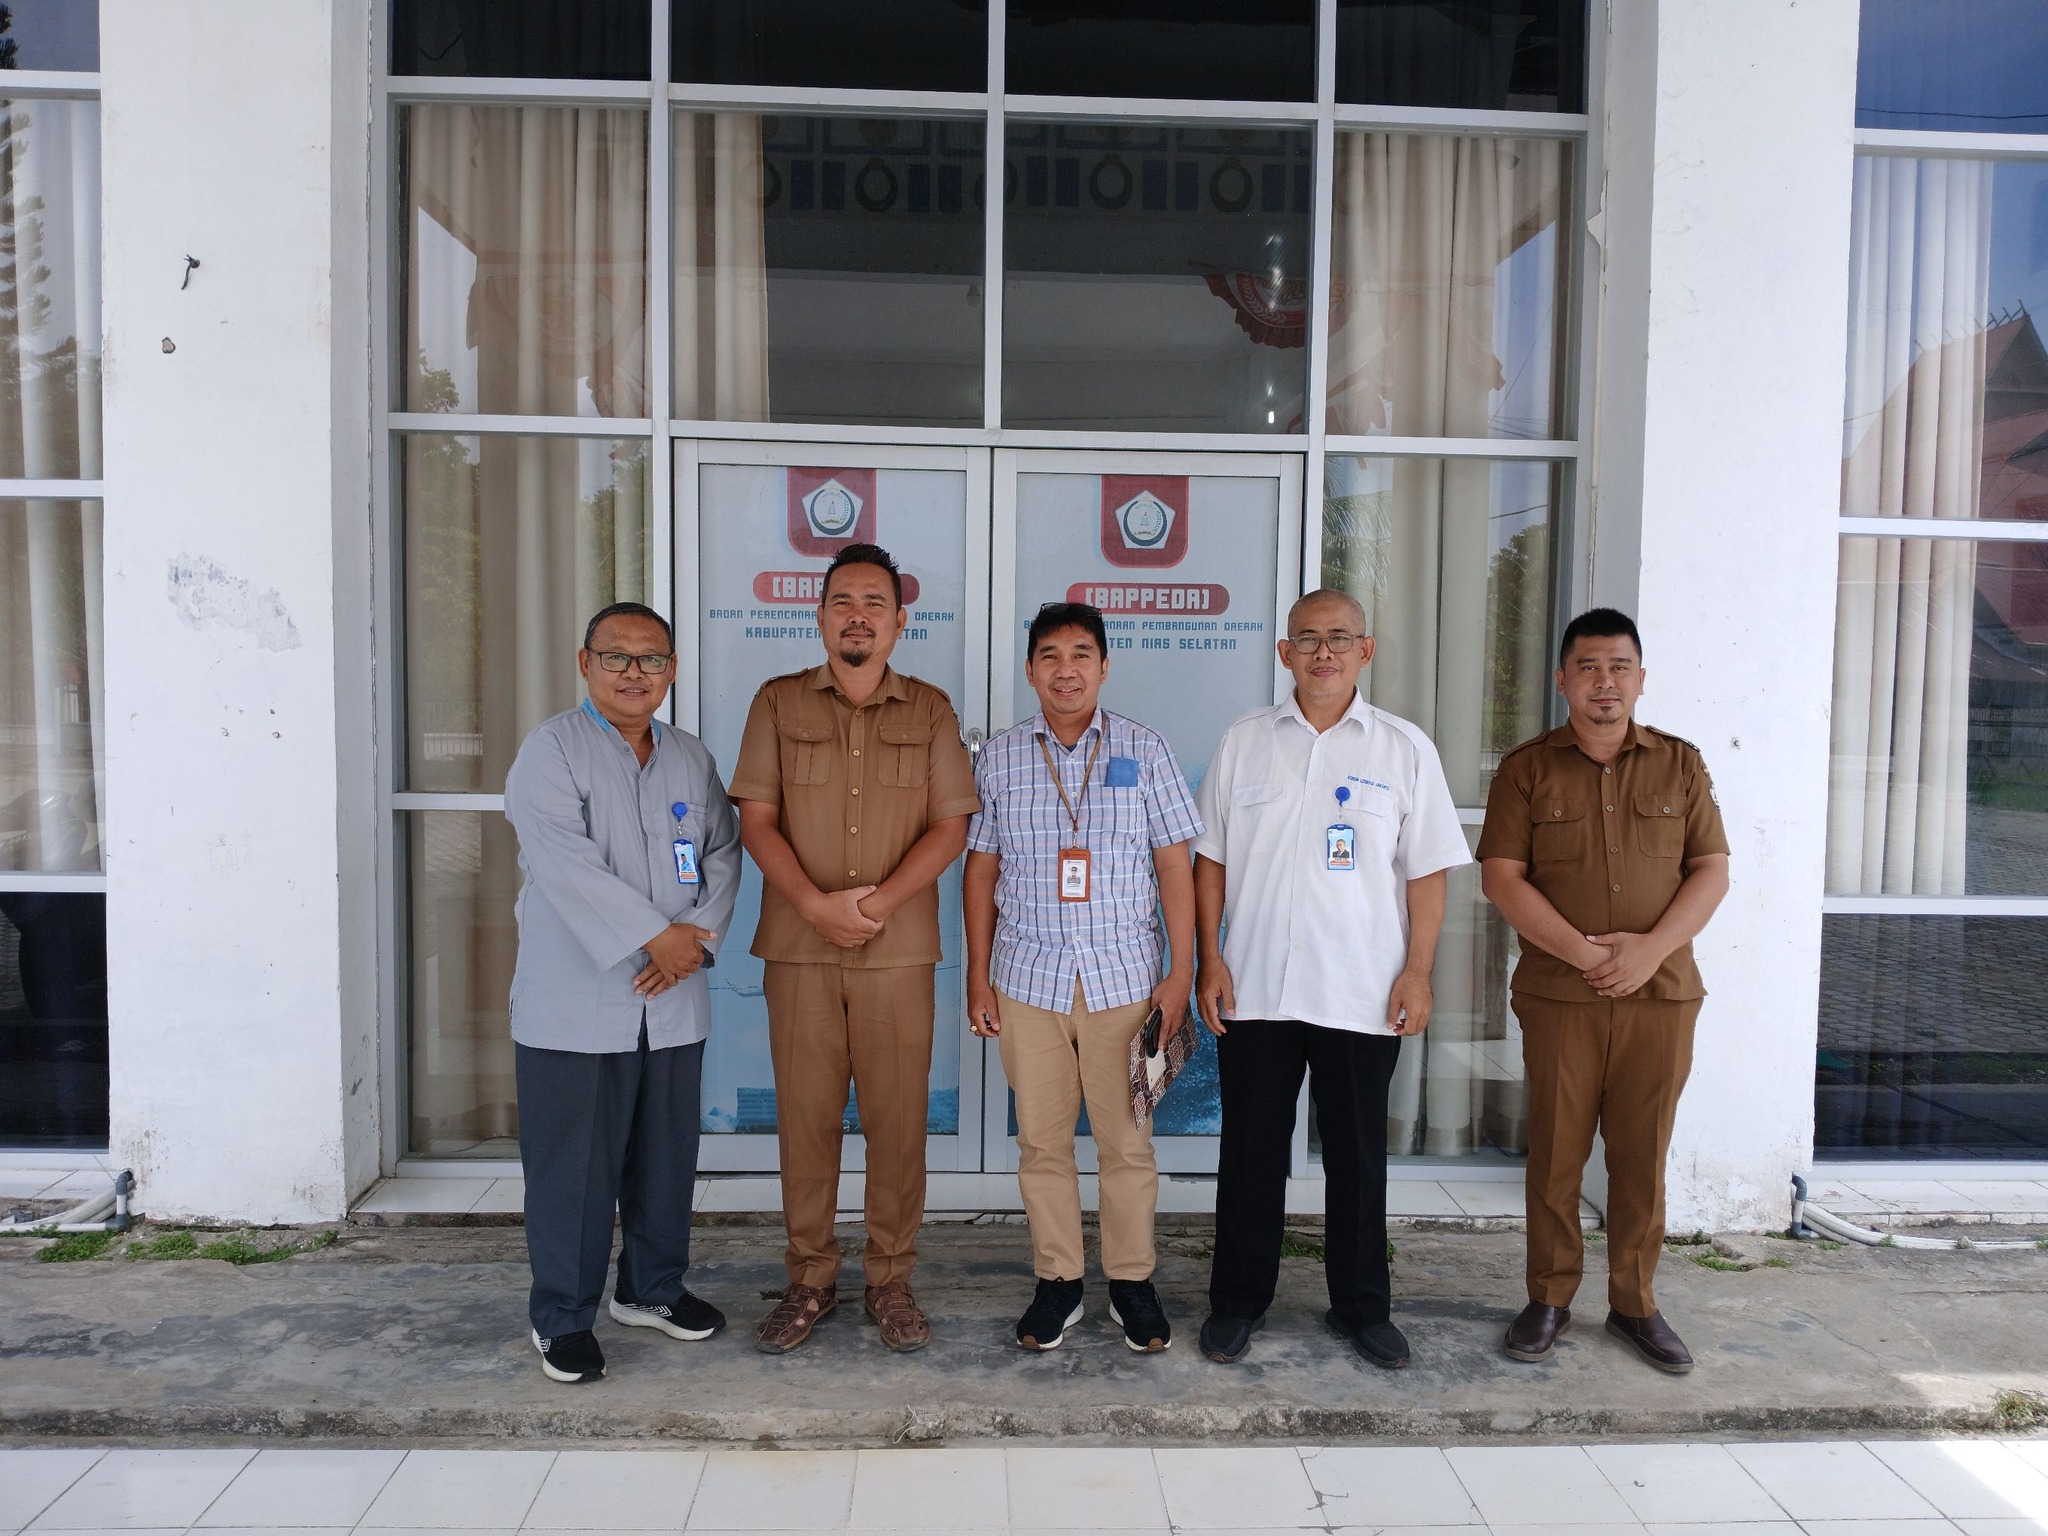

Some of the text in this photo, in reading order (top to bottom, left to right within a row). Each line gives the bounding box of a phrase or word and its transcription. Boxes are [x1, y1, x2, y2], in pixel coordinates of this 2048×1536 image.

[709, 609, 954, 621] BADAN PERENCANAA DAERAH
[745, 626, 822, 639] KABUPATEN
[1142, 621, 1218, 631] PEMBANGUNAN
[1224, 622, 1263, 632] DAERAH
[1141, 638, 1170, 649] NIAS
[1179, 638, 1237, 650] SELATAN
